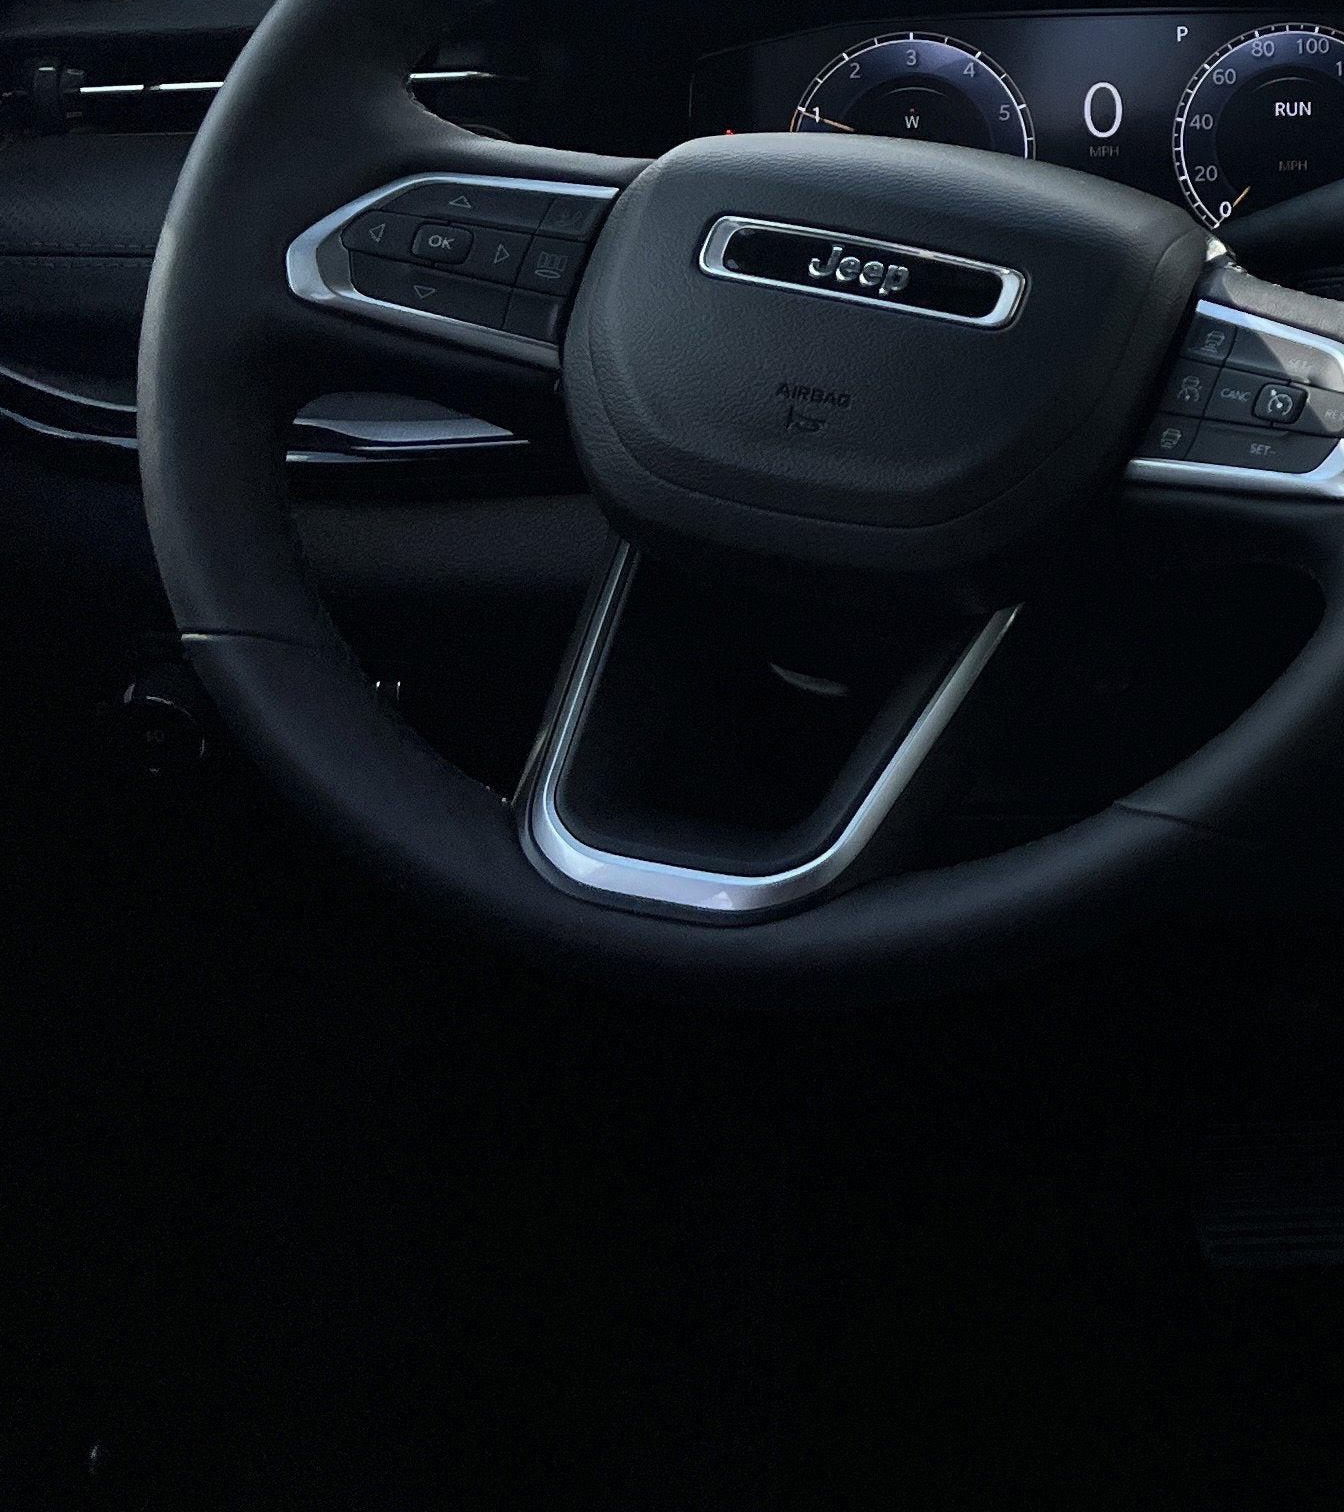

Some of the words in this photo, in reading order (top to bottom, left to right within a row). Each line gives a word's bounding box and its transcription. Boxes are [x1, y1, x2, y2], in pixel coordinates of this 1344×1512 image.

[1176, 26, 1188, 42] P
[1251, 40, 1275, 57] 80
[1296, 38, 1330, 54] 100
[906, 50, 917, 66] 3
[850, 63, 861, 78] 2
[963, 63, 976, 78] 4
[1212, 68, 1236, 85] 60
[1000, 105, 1010, 121] 5
[1084, 81, 1123, 138] 0
[1274, 102, 1312, 117] RUN
[904, 115, 920, 129] W
[1189, 114, 1214, 130] 40
[1089, 145, 1119, 157] MPH
[1279, 159, 1308, 171] MPH
[1194, 165, 1218, 182] 20
[1219, 201, 1231, 217] 0
[428, 235, 455, 250] OK
[808, 245, 910, 296] Jeep
[775, 382, 851, 407] AIRBAG
[1221, 389, 1251, 403] CANC
[1325, 409, 1344, 421] RES
